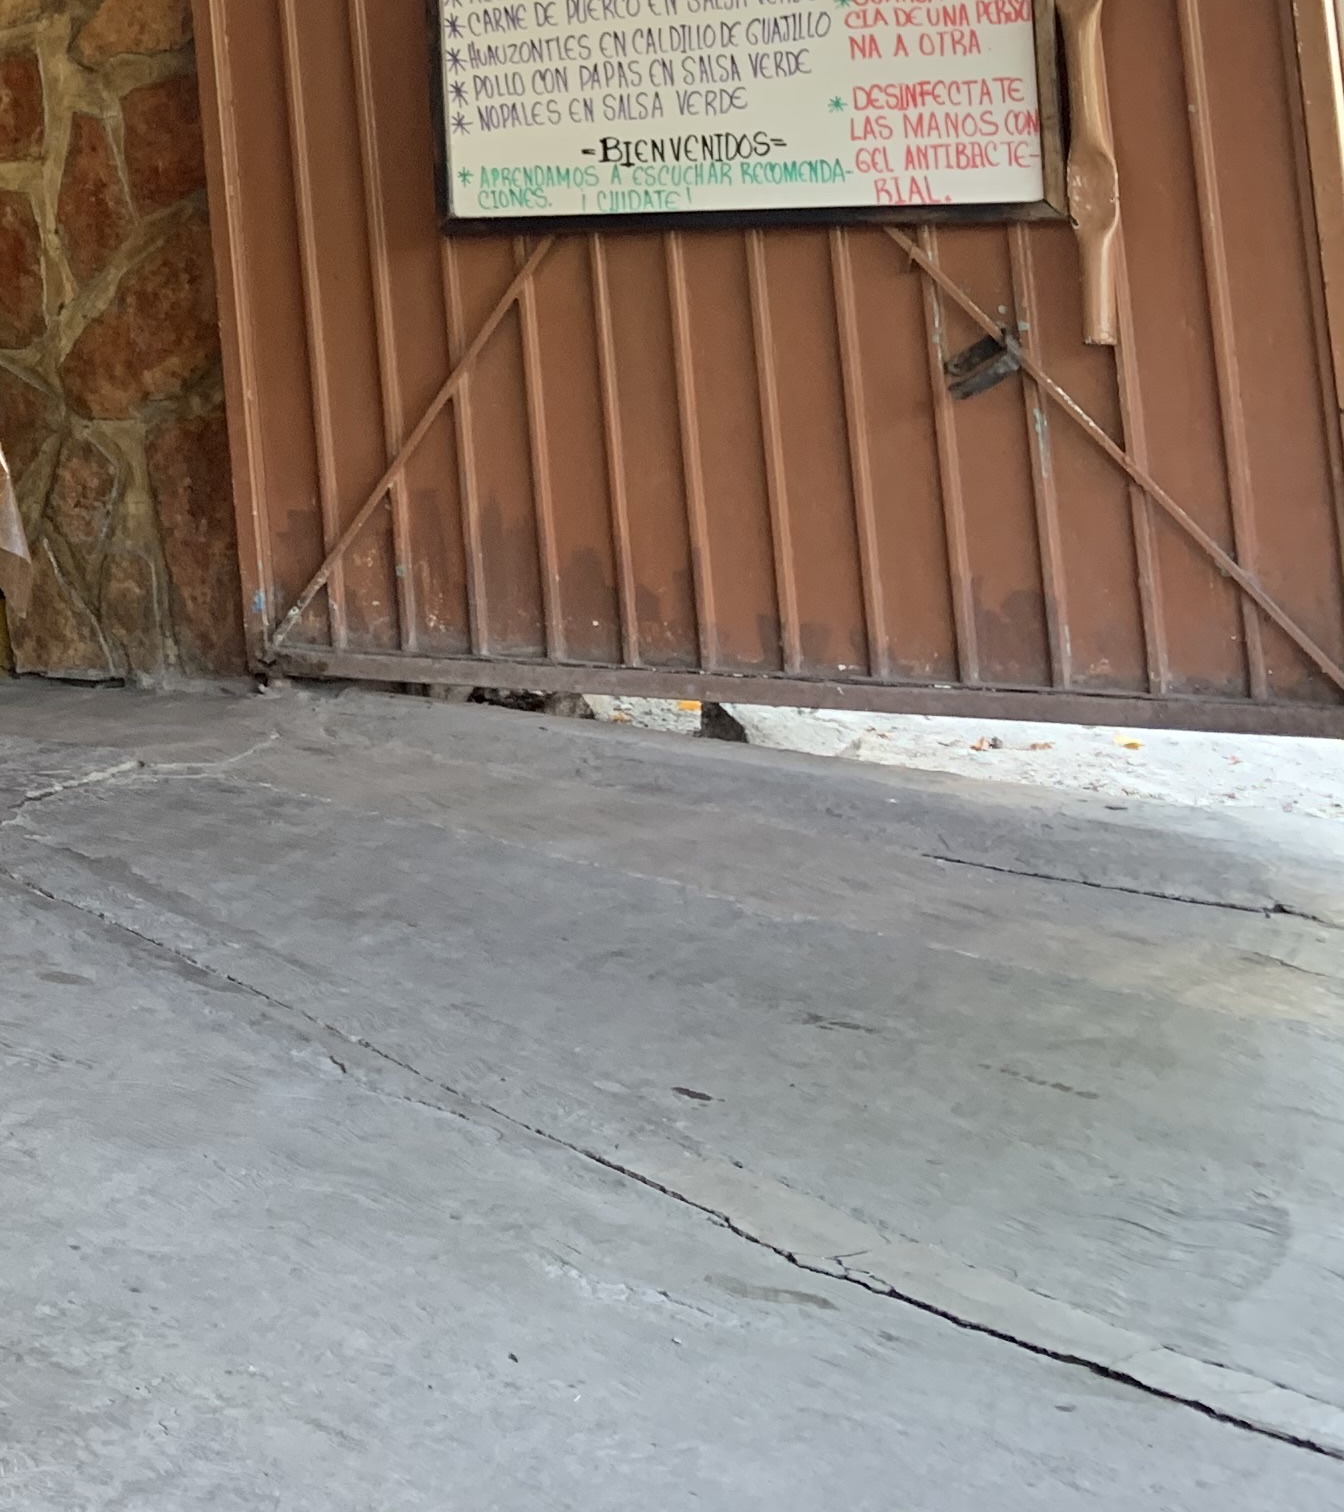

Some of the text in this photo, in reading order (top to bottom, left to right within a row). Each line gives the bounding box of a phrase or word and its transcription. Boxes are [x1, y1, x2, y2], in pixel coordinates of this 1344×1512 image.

[467, 3, 528, 37] CARNE
[534, 1, 559, 27] DE
[844, 7, 888, 29] CIA
[894, 7, 923, 27] DE
[926, 3, 970, 27] UNA
[467, 11, 832, 69] HUAUZONTLES EN CALDILLO DE GUAJILLO
[848, 29, 980, 60] NA A OTRA
[473, 48, 812, 101] POLLO CON PAPAS EN SALSA VERDE
[476, 86, 748, 132] NOPALES EN SALSA VERDE
[852, 77, 1025, 111] DESINFECTATE
[850, 109, 1041, 142] LAS MANOS CON
[480, 165, 599, 188] APRENDAMOS
[611, 164, 622, 186] A
[631, 161, 732, 187] ESCUCHAR
[855, 146, 894, 173] GEL
